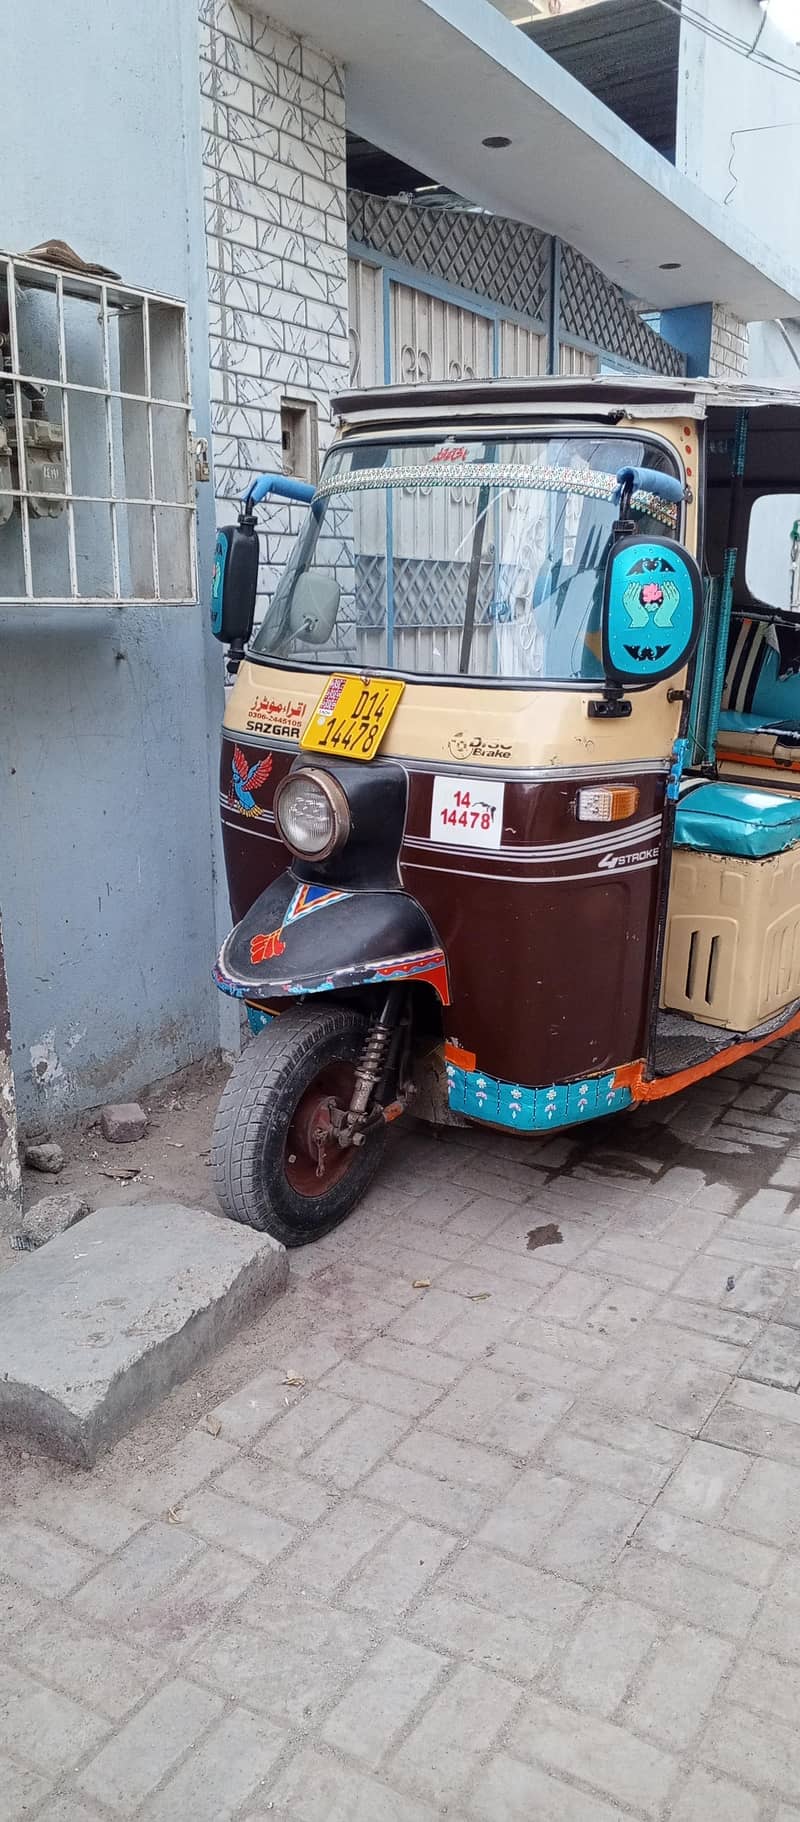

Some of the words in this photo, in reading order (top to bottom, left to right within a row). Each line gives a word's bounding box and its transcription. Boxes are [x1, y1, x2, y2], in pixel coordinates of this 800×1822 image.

[350, 690, 389, 722] D14
[246, 720, 300, 738] SAZGAR
[318, 718, 379, 752] 14478
[472, 748, 511, 759] Brake
[453, 790, 471, 808] 14
[440, 808, 490, 830] 14478
